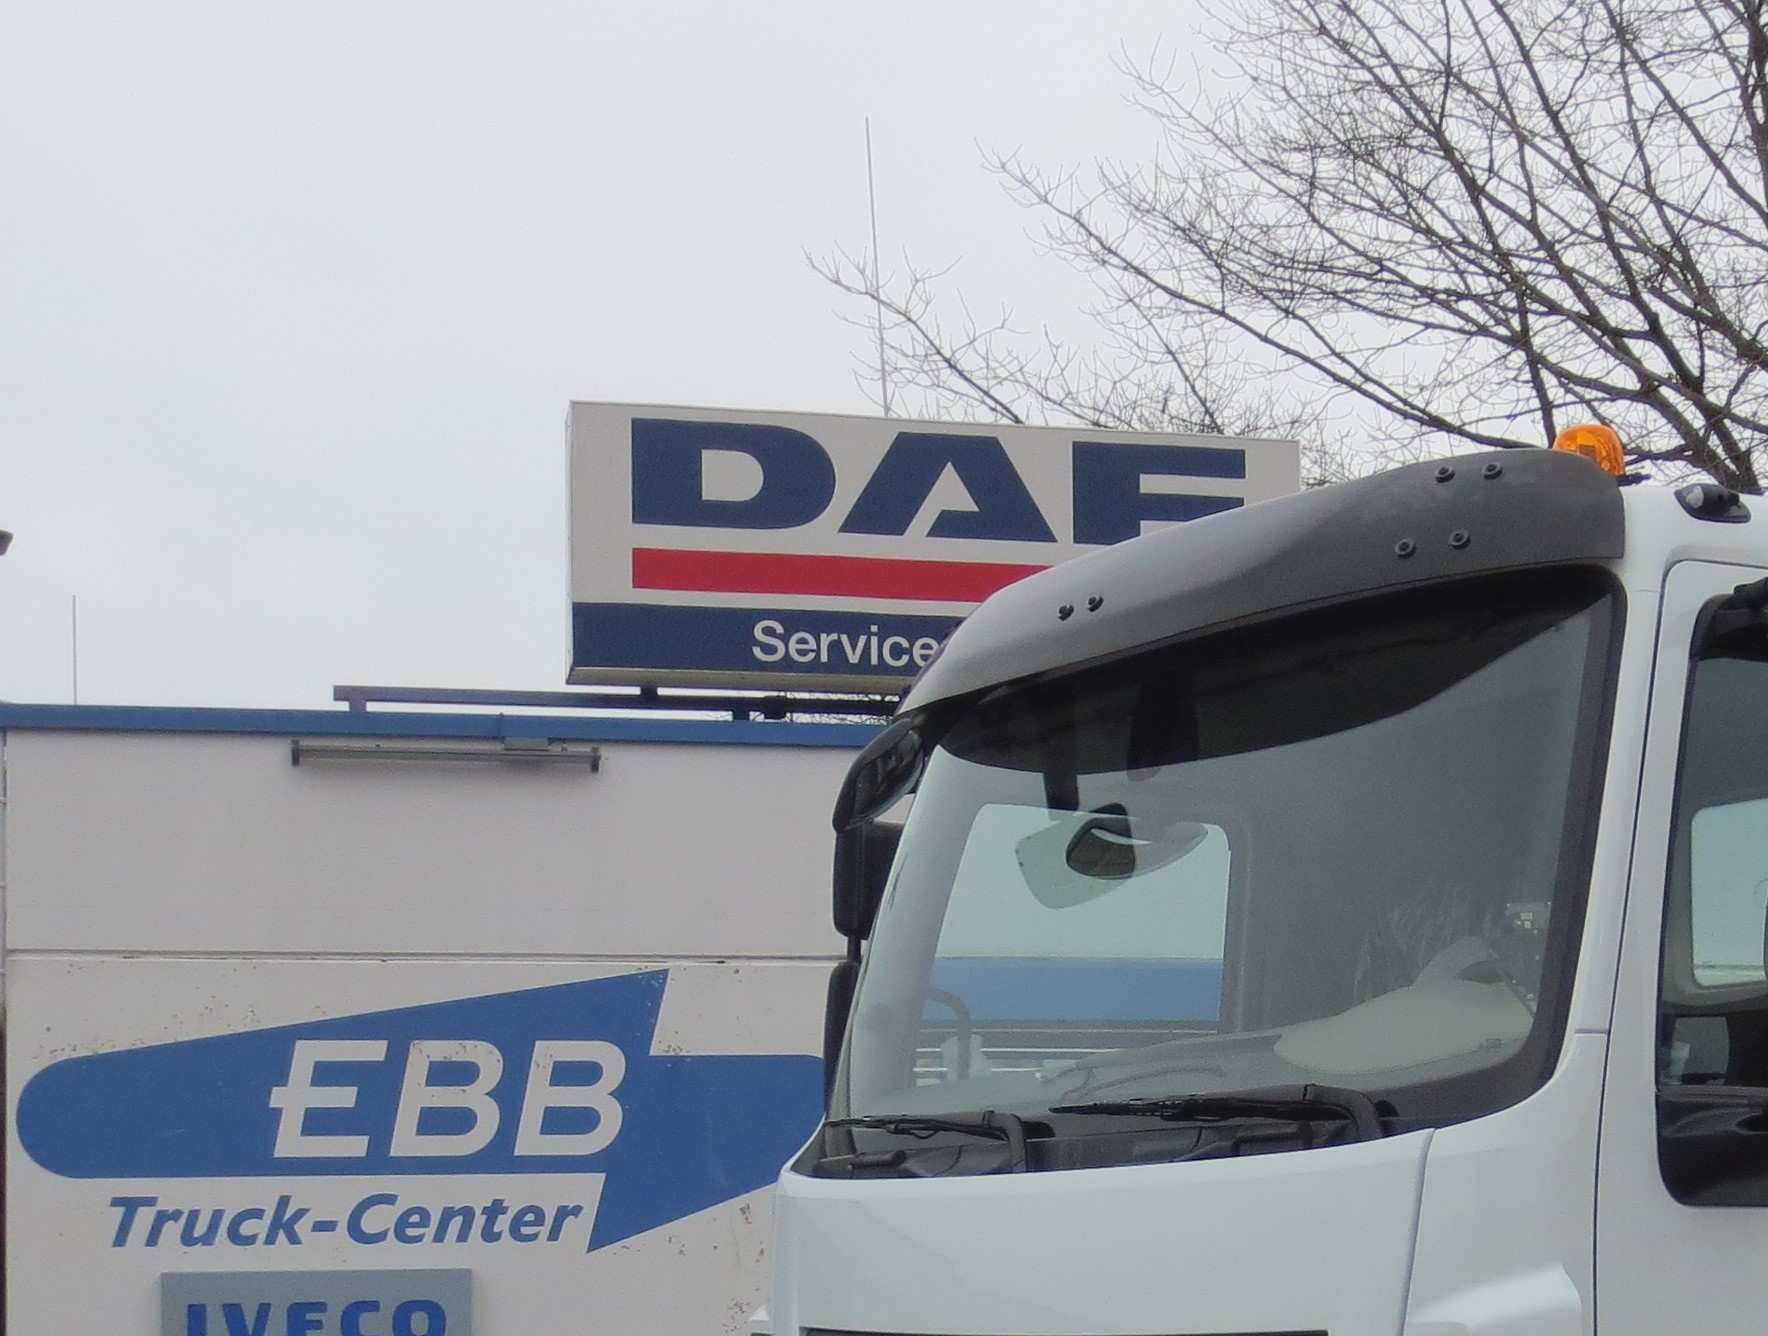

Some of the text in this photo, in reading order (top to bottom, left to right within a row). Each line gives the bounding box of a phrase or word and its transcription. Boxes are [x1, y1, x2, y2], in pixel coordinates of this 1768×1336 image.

[631, 418, 1246, 545] DAF
[751, 619, 938, 667] Service
[269, 1040, 626, 1159] EBB
[108, 1193, 583, 1249] Truck-Center
